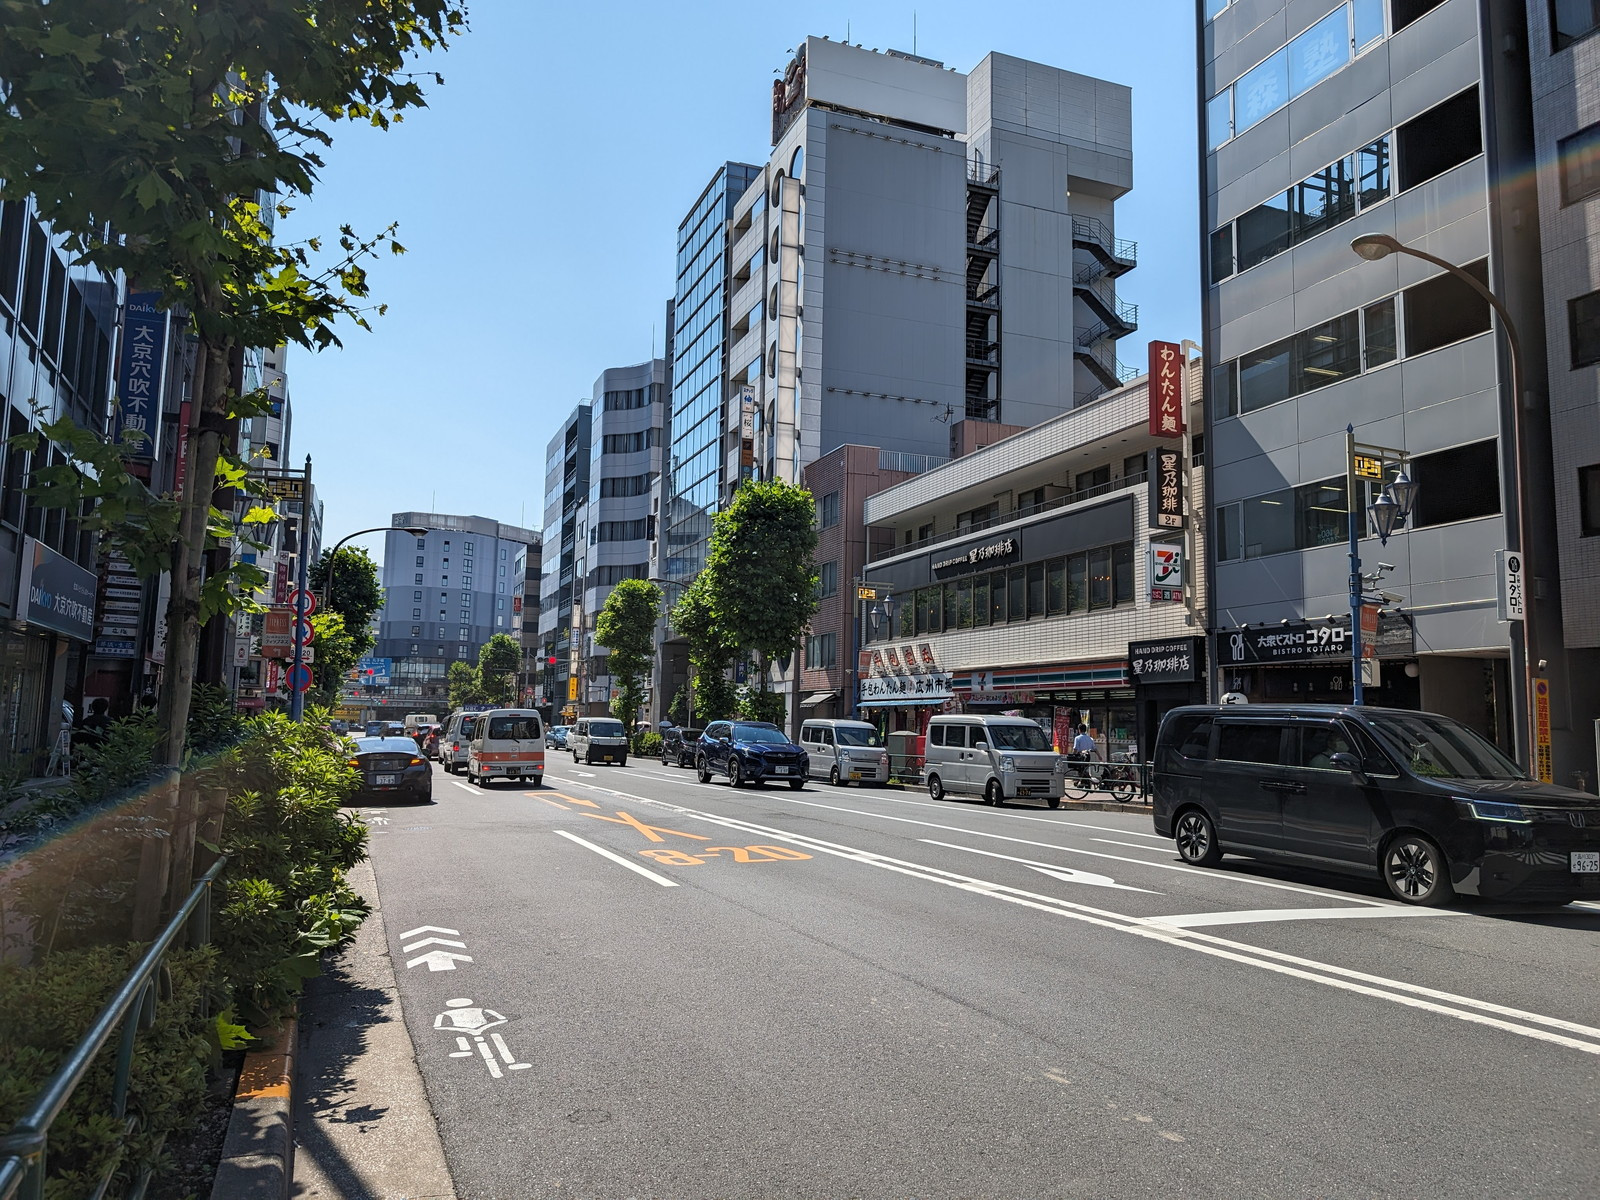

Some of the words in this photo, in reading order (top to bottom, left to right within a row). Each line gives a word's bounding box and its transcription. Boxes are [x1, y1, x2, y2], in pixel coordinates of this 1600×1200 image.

[1160, 344, 1178, 433] わんたん麺
[1160, 453, 1178, 513] 星乃珈琲
[1164, 515, 1177, 526] 2F
[969, 538, 1013, 564] 星乃珈琲店
[1172, 591, 1182, 599] ATM
[1508, 573, 1517, 613] コタロー
[53, 592, 93, 626] 大京穴吹不動産
[237, 612, 245, 637] ラーメン
[1257, 633, 1304, 648] 大衆ビストロ
[1306, 626, 1353, 646] コタロー
[1134, 647, 1151, 655] HAND
[1165, 643, 1188, 652] COFFEE
[1272, 647, 1303, 656] BISTRO
[1306, 644, 1343, 653] KOTARO
[1132, 654, 1190, 675] 星乃珈琲店
[1538, 697, 1549, 744] 違法駐車禁止
[638, 845, 814, 866] 8-20
[1576, 860, 1599, 872] 96-25
